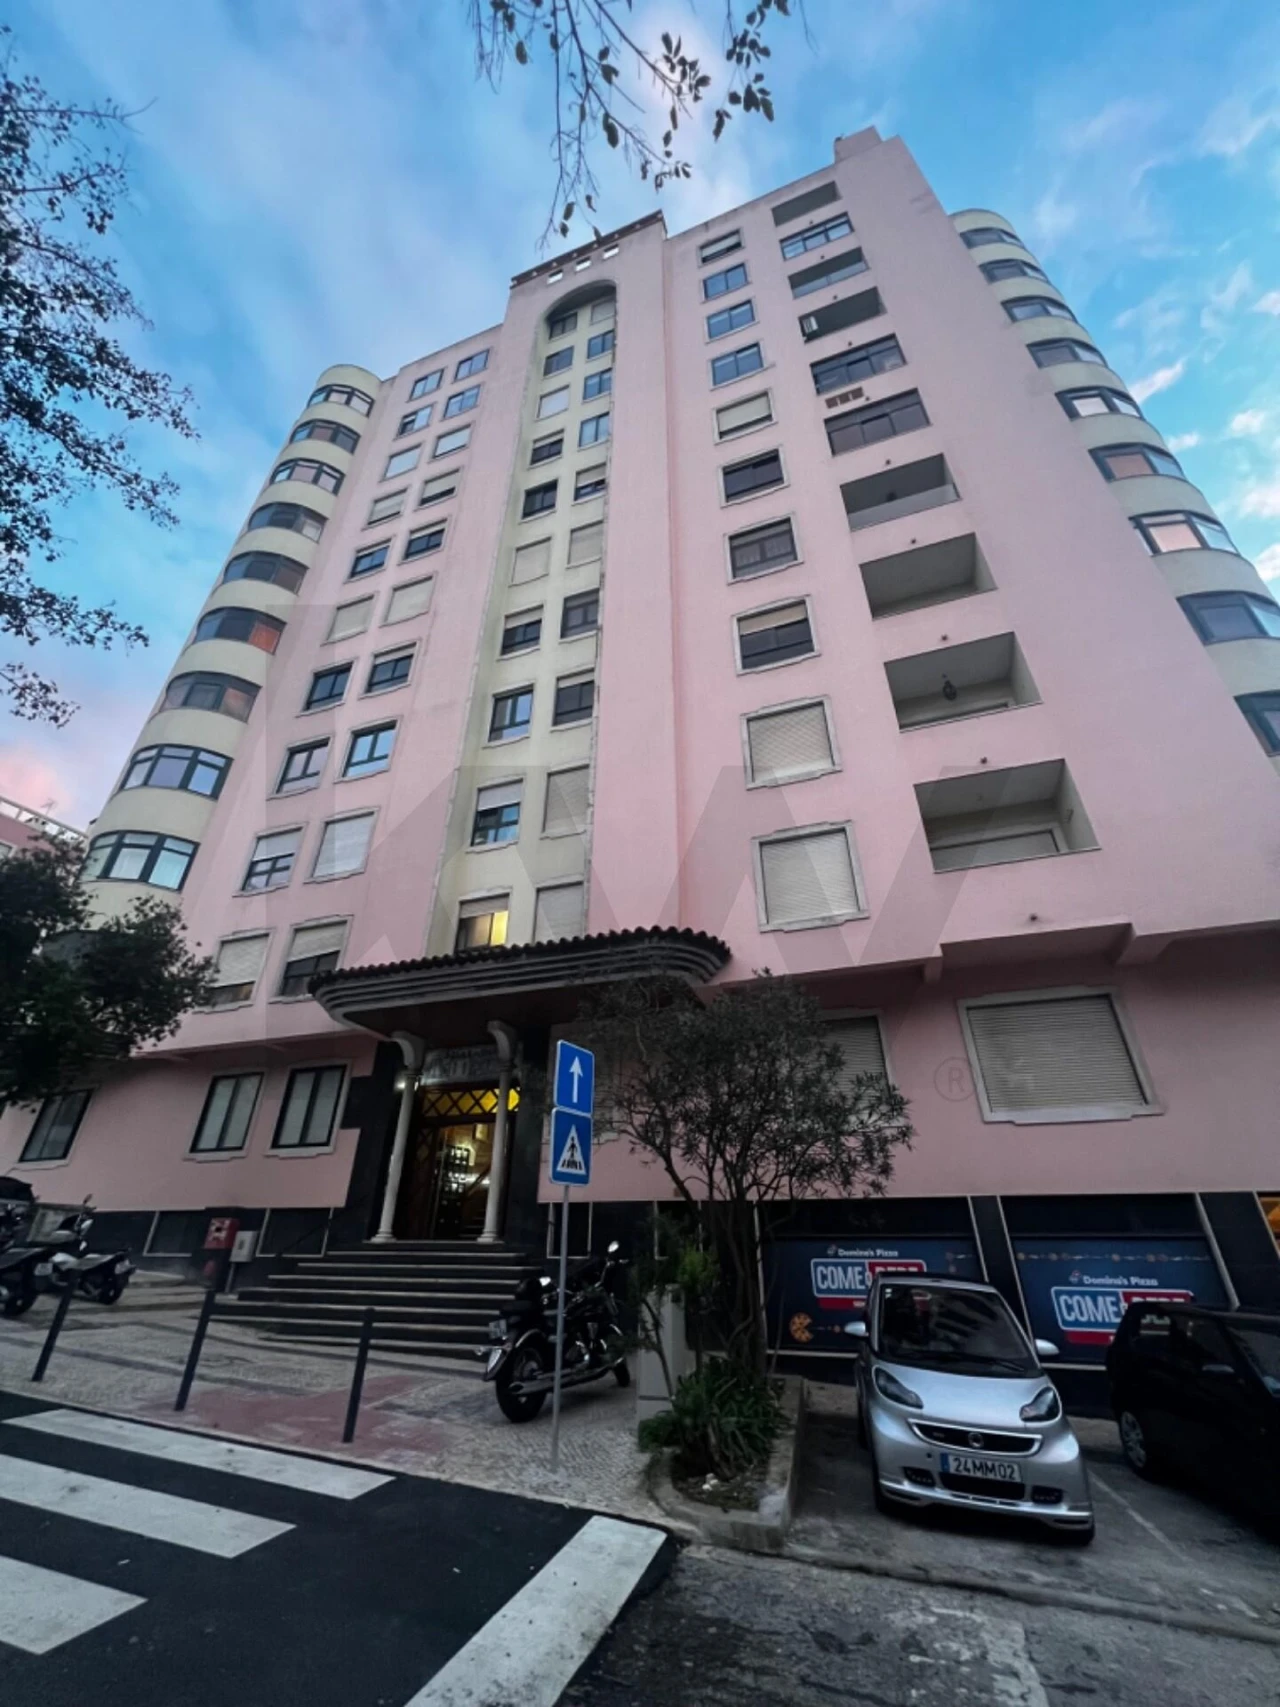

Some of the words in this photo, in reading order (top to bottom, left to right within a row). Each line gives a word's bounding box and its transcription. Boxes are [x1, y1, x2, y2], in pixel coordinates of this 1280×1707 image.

[876, 1249, 898, 1257] Pizza
[816, 1266, 866, 1290] COME
[1083, 1275, 1128, 1285] Domino's
[1130, 1276, 1158, 1286] Pizza
[1059, 1294, 1121, 1323] COME
[953, 1457, 1015, 1480] 24MM02
